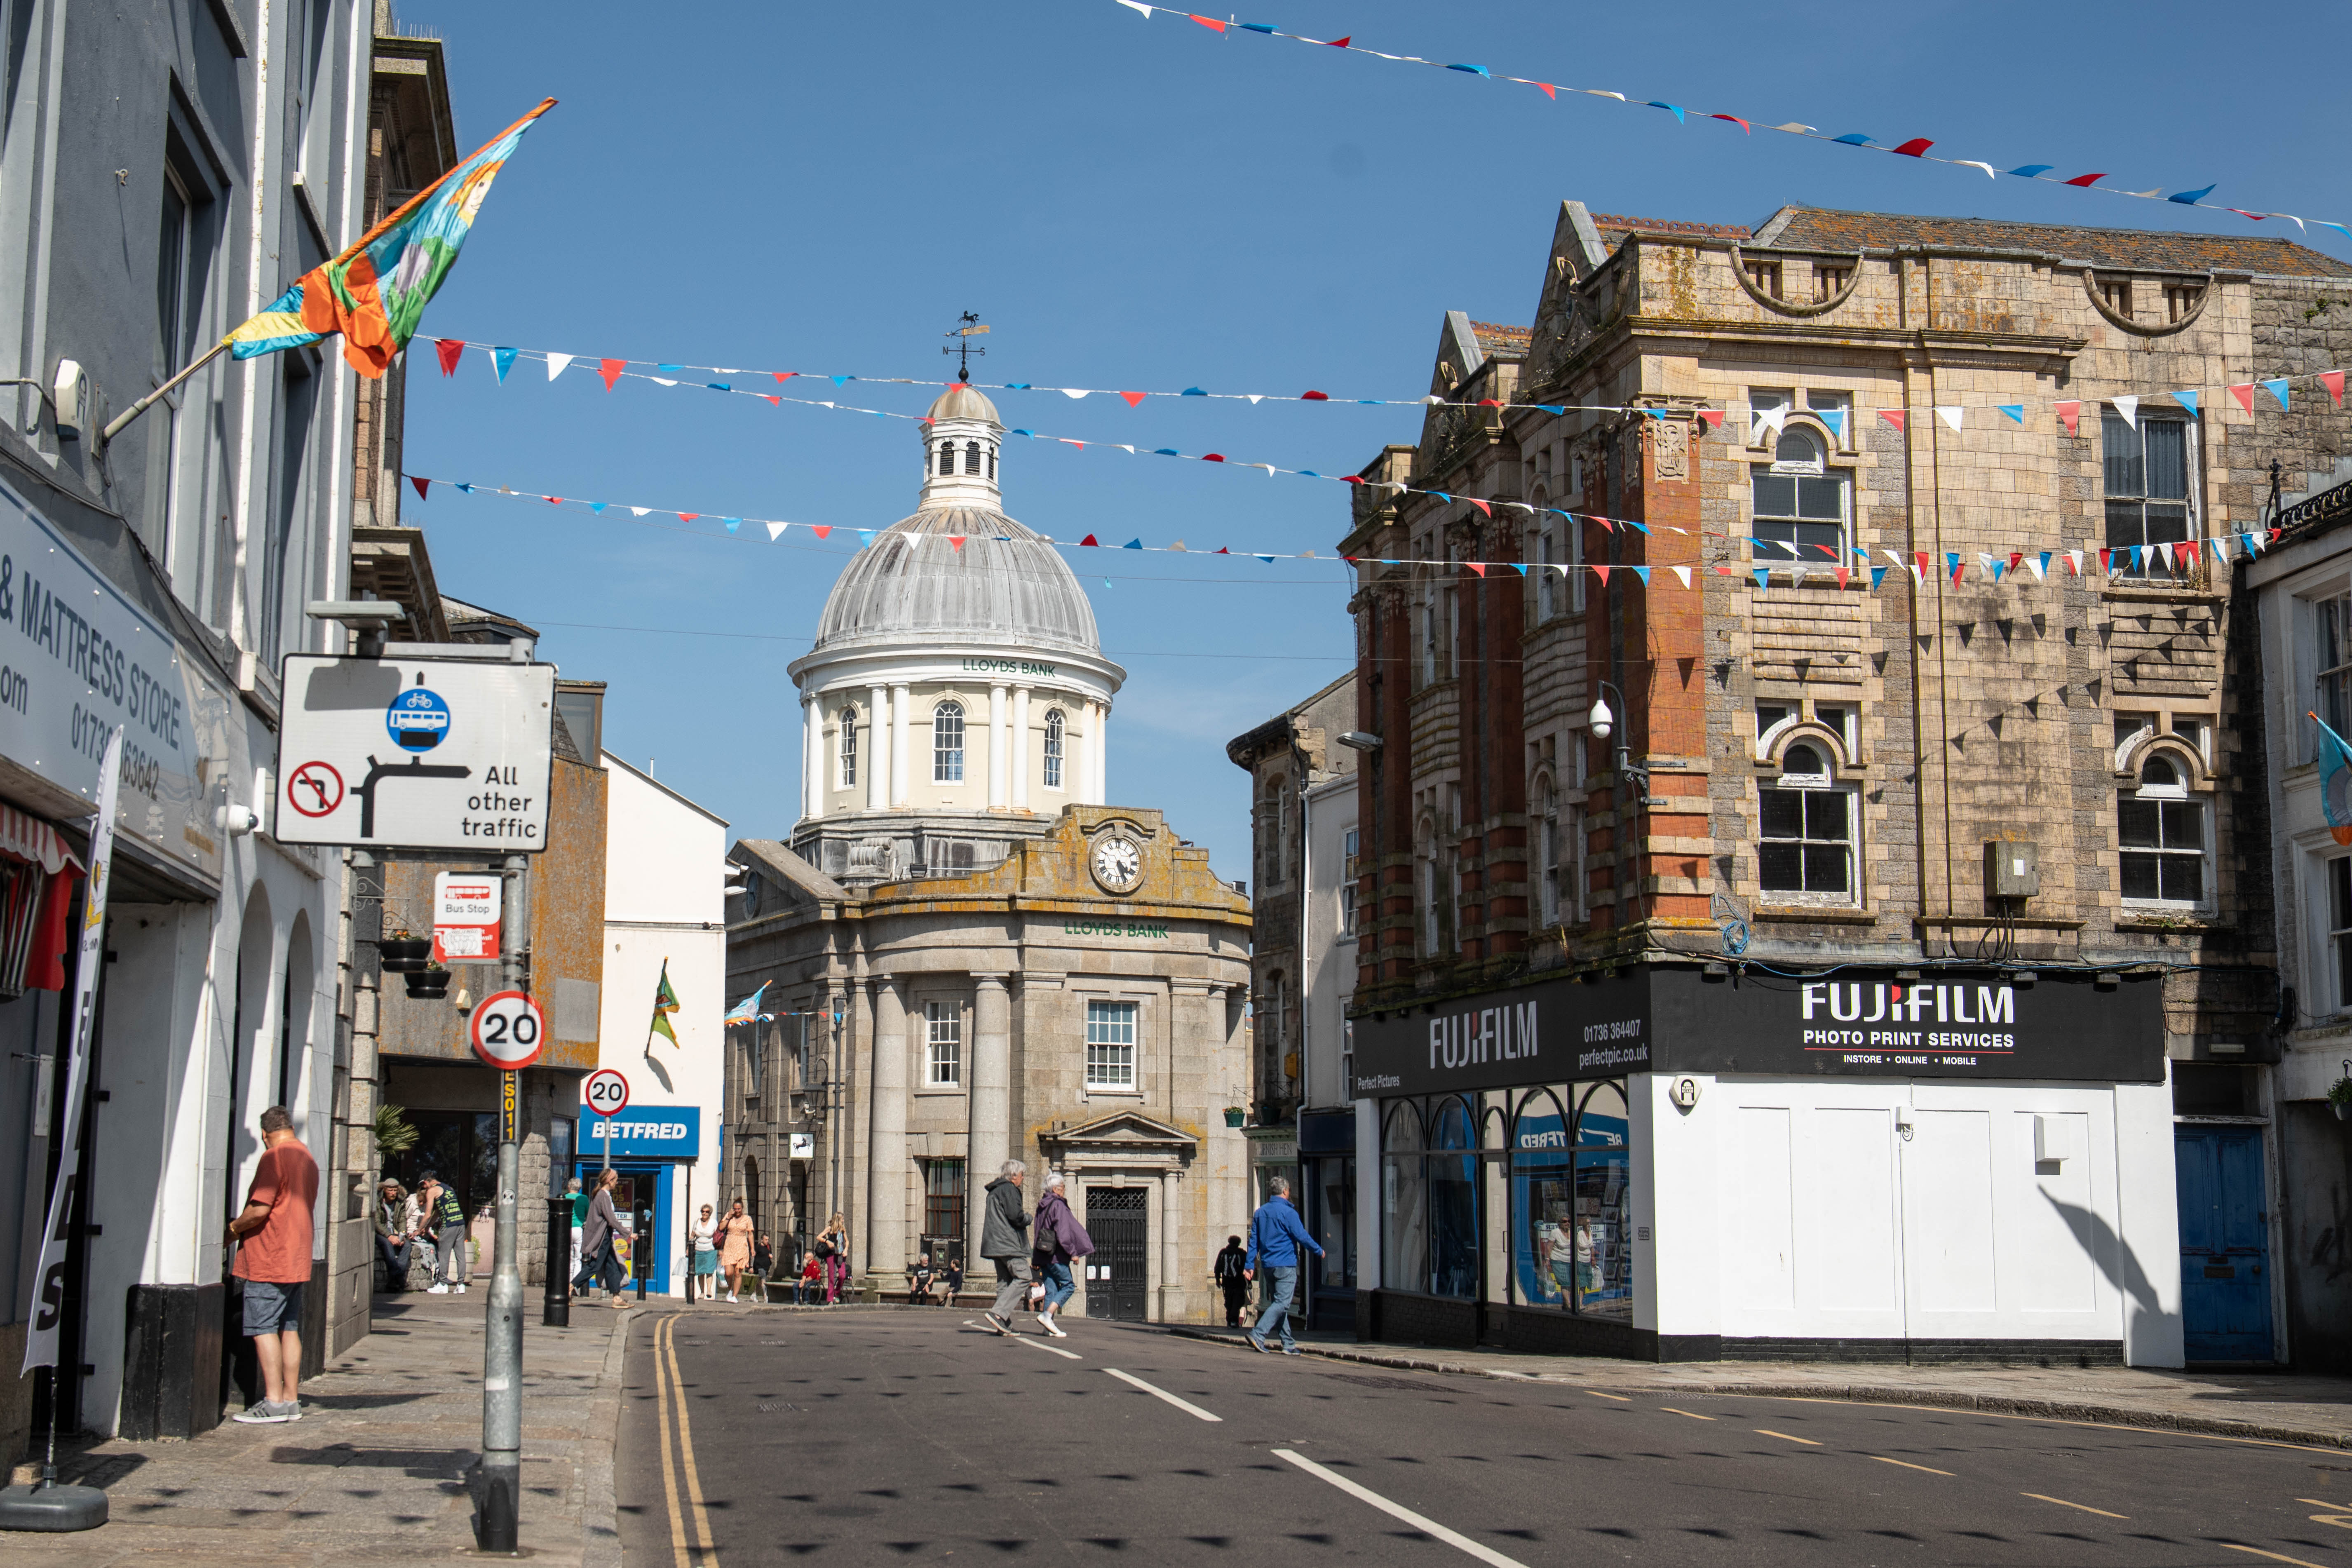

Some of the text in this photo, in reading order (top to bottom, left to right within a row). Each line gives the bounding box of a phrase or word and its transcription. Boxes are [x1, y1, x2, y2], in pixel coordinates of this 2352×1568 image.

[0, 554, 181, 751] & MATTRESS STORE
[963, 659, 1056, 678] LLOYDS BANK
[119, 736, 159, 801] 63642
[485, 766, 518, 785] All
[468, 792, 531, 812] other
[462, 817, 537, 838] traffic
[446, 904, 490, 915] Bus Stop
[1065, 920, 1168, 939] LLOYDS BANK
[1803, 983, 2014, 1023] FUJIFILM
[485, 1013, 537, 1045] 20
[1430, 1000, 1537, 1069] FUJIFILM
[1584, 1019, 1641, 1042] 01736 364407
[1803, 1030, 2014, 1047] PHOTO PRINT SERVICES
[1579, 1042, 1648, 1070] perfectpic.co.uk
[1844, 1054, 1976, 1065] INSTORE ONLINE MOBILE
[593, 1082, 622, 1101] 20
[1358, 1074, 1400, 1090] Perfect Pictures
[592, 1122, 687, 1140] BETFRED
